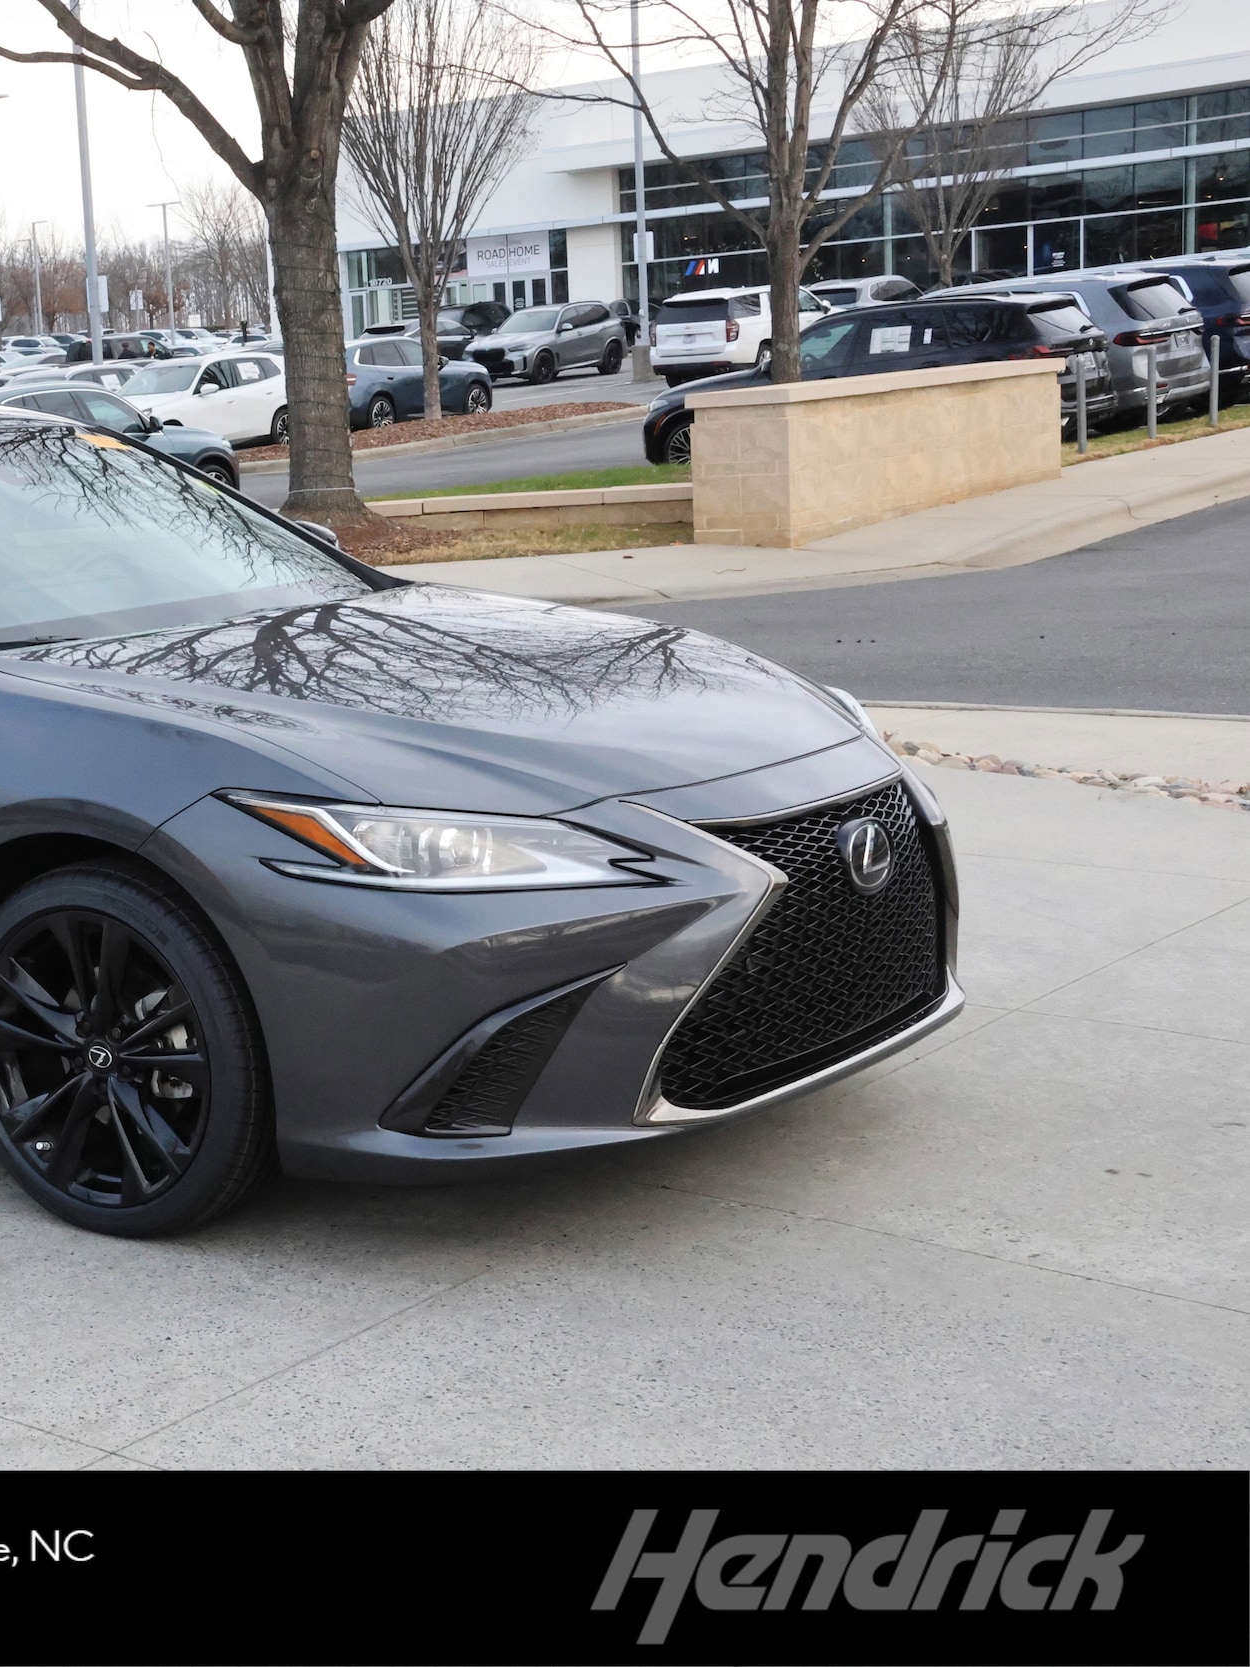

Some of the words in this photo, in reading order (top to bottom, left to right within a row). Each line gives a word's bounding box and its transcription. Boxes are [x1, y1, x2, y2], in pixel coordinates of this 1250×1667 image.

[477, 248, 506, 261] ROAD
[508, 244, 541, 258] HOME
[486, 259, 507, 268] SALES
[508, 256, 531, 267] EVENT
[368, 276, 393, 287] 10720
